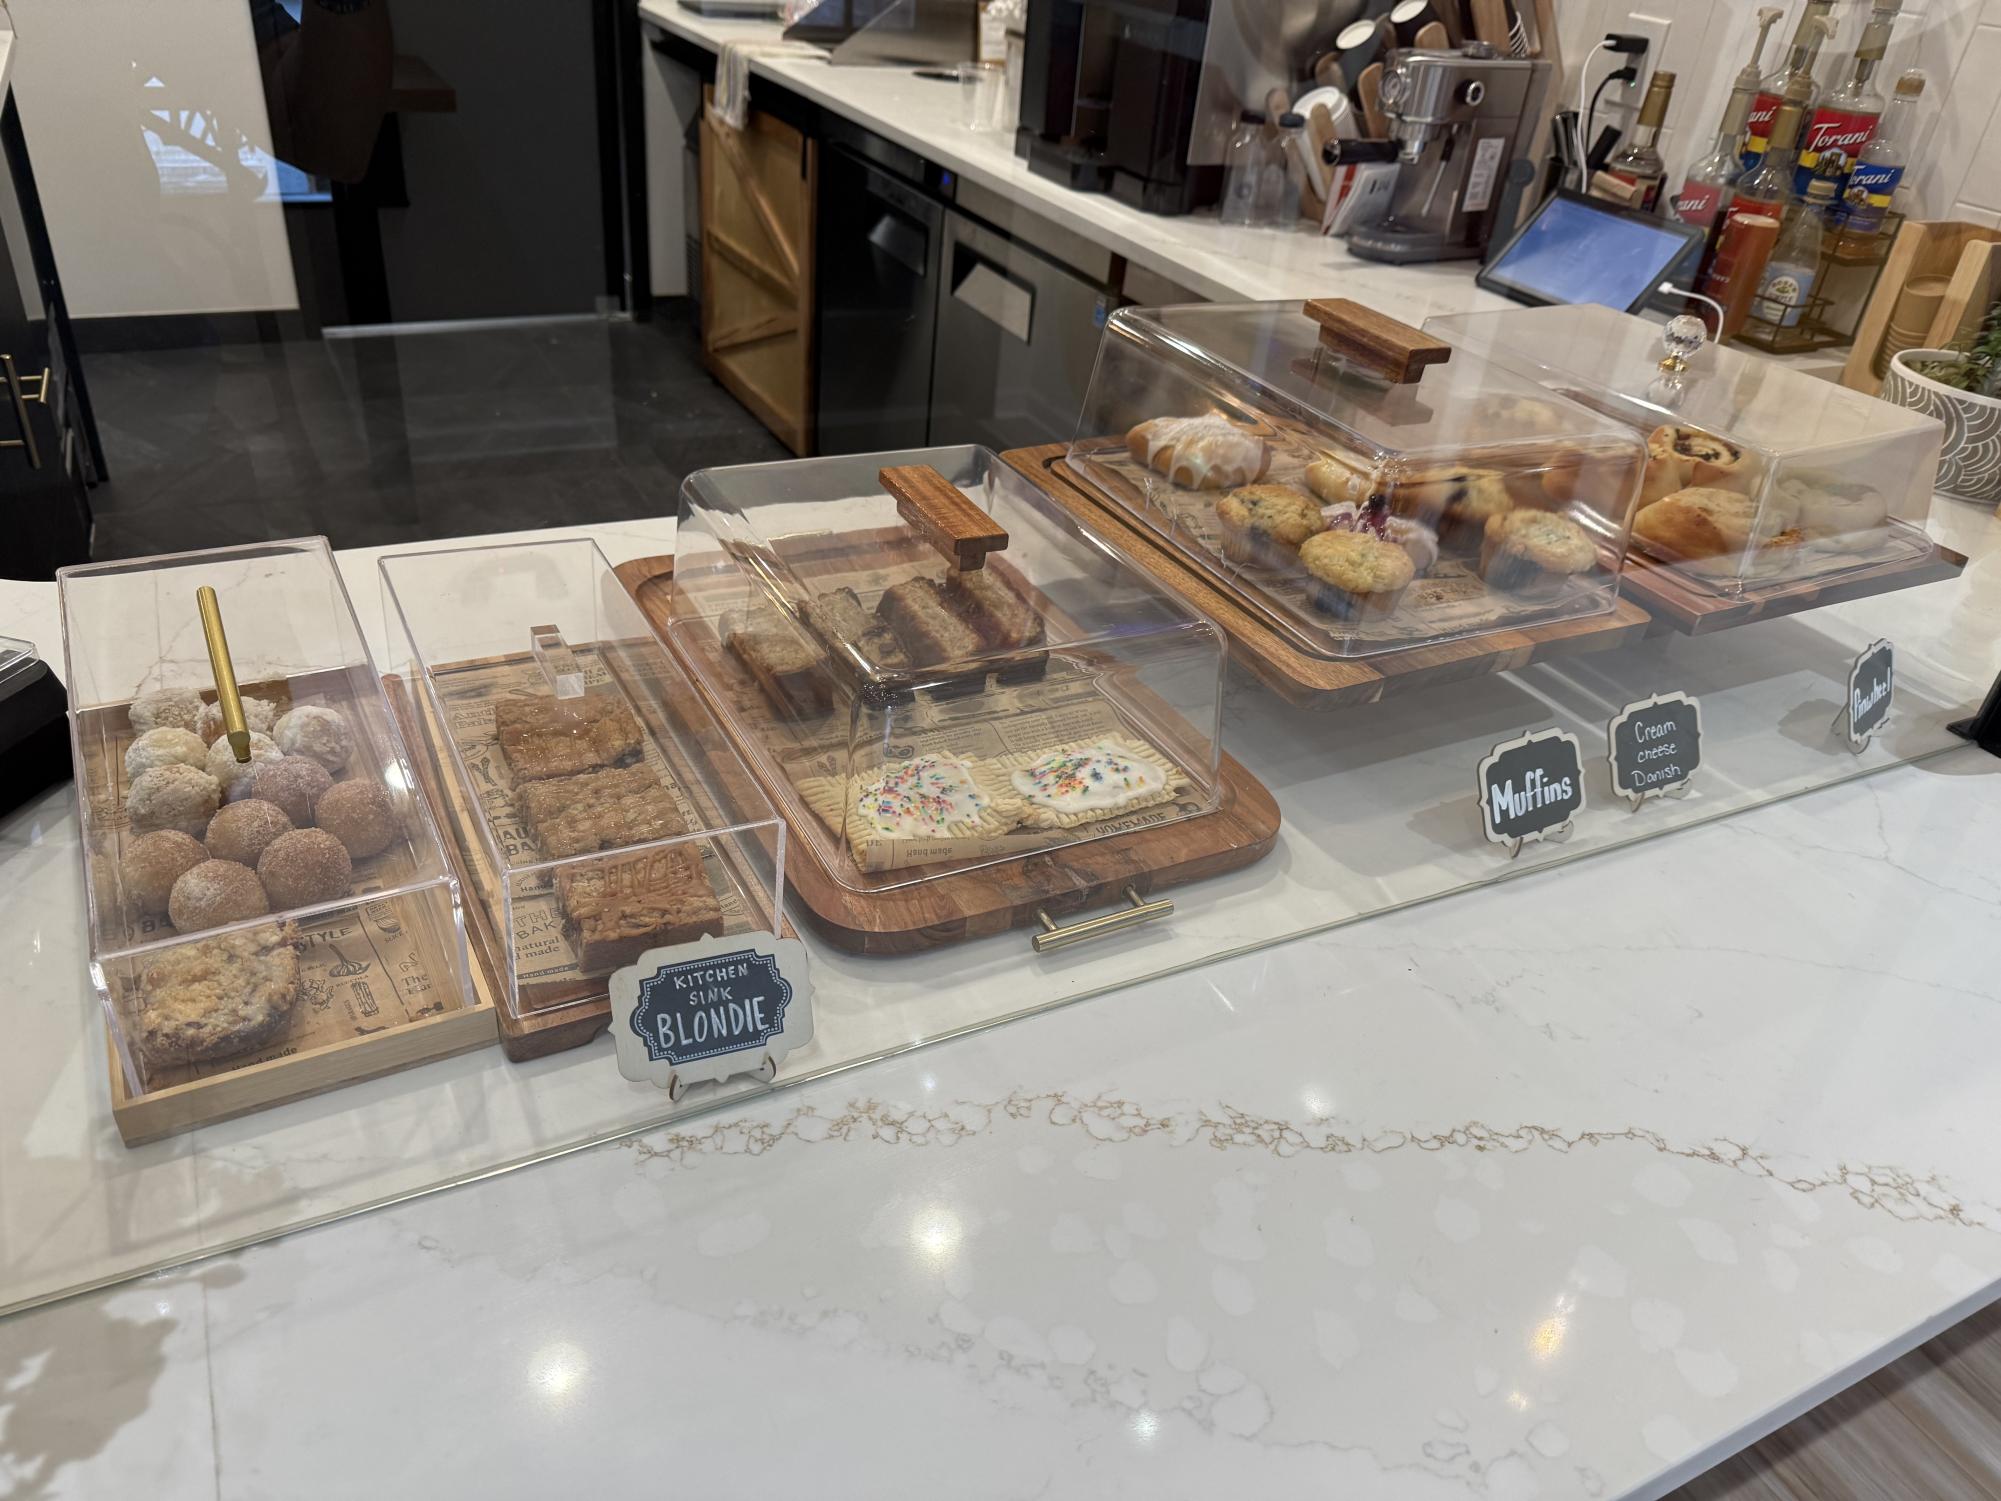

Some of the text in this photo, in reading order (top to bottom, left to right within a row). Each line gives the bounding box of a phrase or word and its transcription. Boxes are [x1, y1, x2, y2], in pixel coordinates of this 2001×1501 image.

[1809, 122, 1873, 153] Torani
[1634, 721, 1676, 743] Cream
[1637, 743, 1678, 763] cheese
[1631, 763, 1682, 787] Danish
[1491, 767, 1573, 824] Muffins
[673, 962, 750, 990] KITCHEN
[688, 986, 733, 1007] SINK
[656, 996, 770, 1049] BLONDIE
